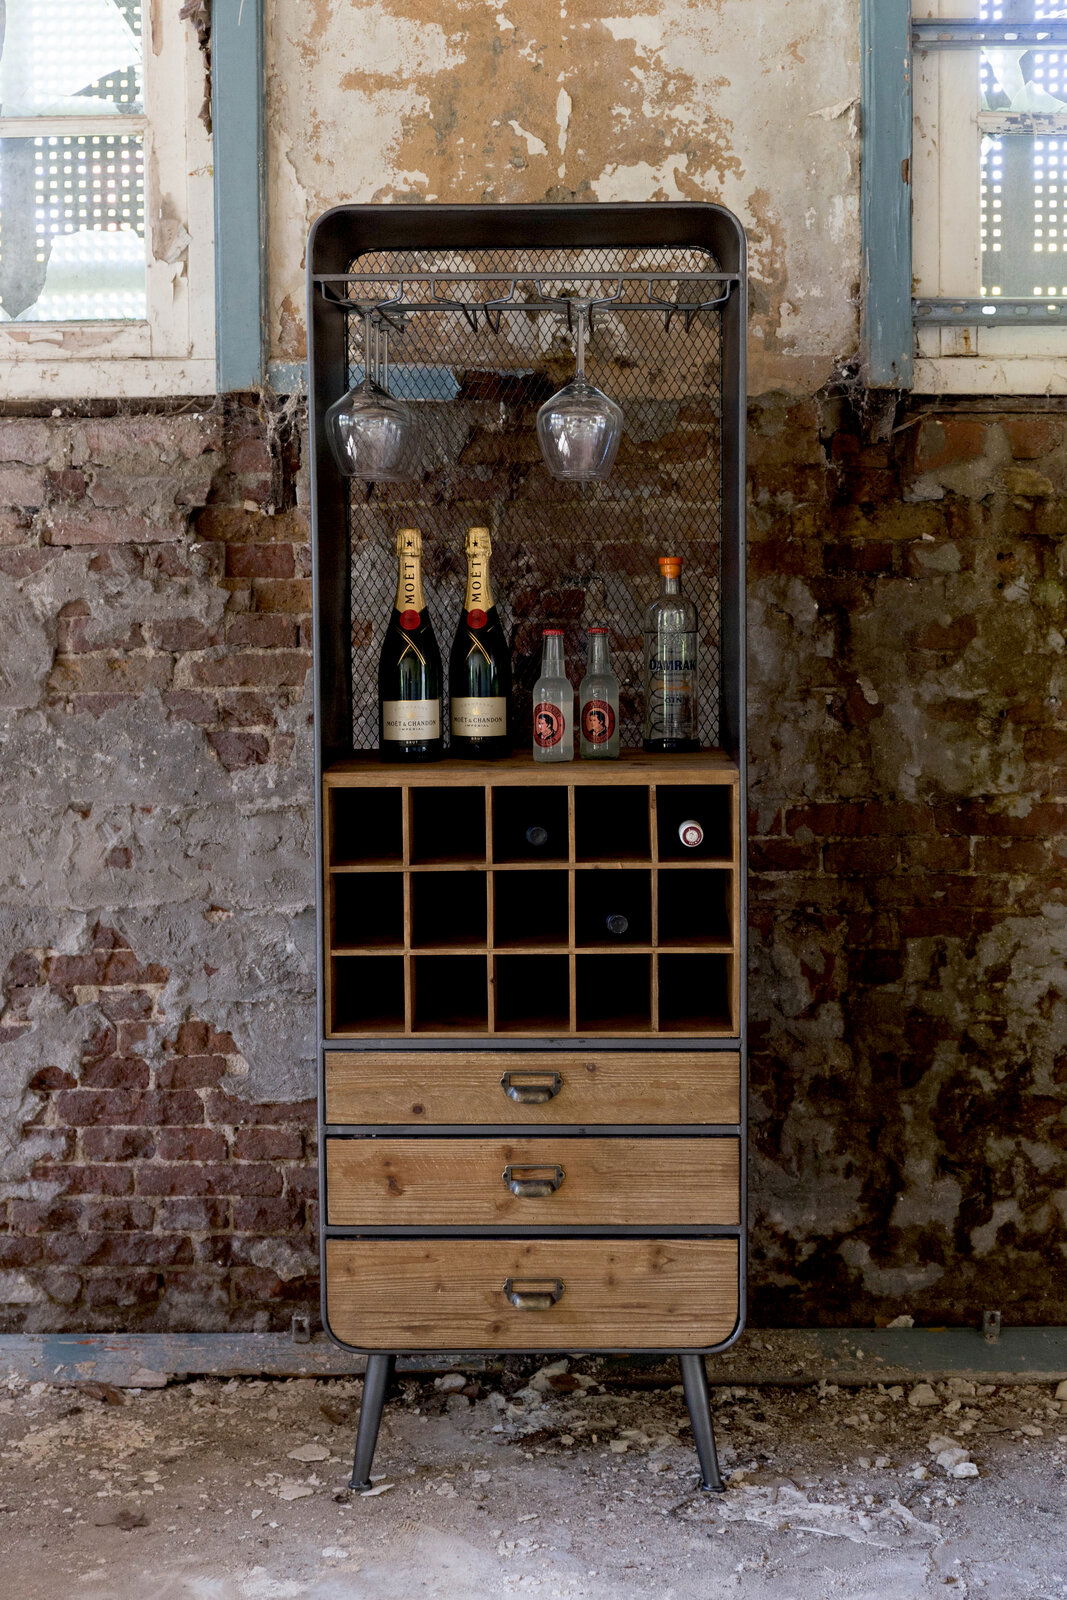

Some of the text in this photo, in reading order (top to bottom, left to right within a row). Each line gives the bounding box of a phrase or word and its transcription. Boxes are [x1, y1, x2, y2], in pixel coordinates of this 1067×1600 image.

[404, 563, 415, 604] MOËT
[470, 560, 482, 603] MOËT
[649, 660, 697, 670] DAMRAK
